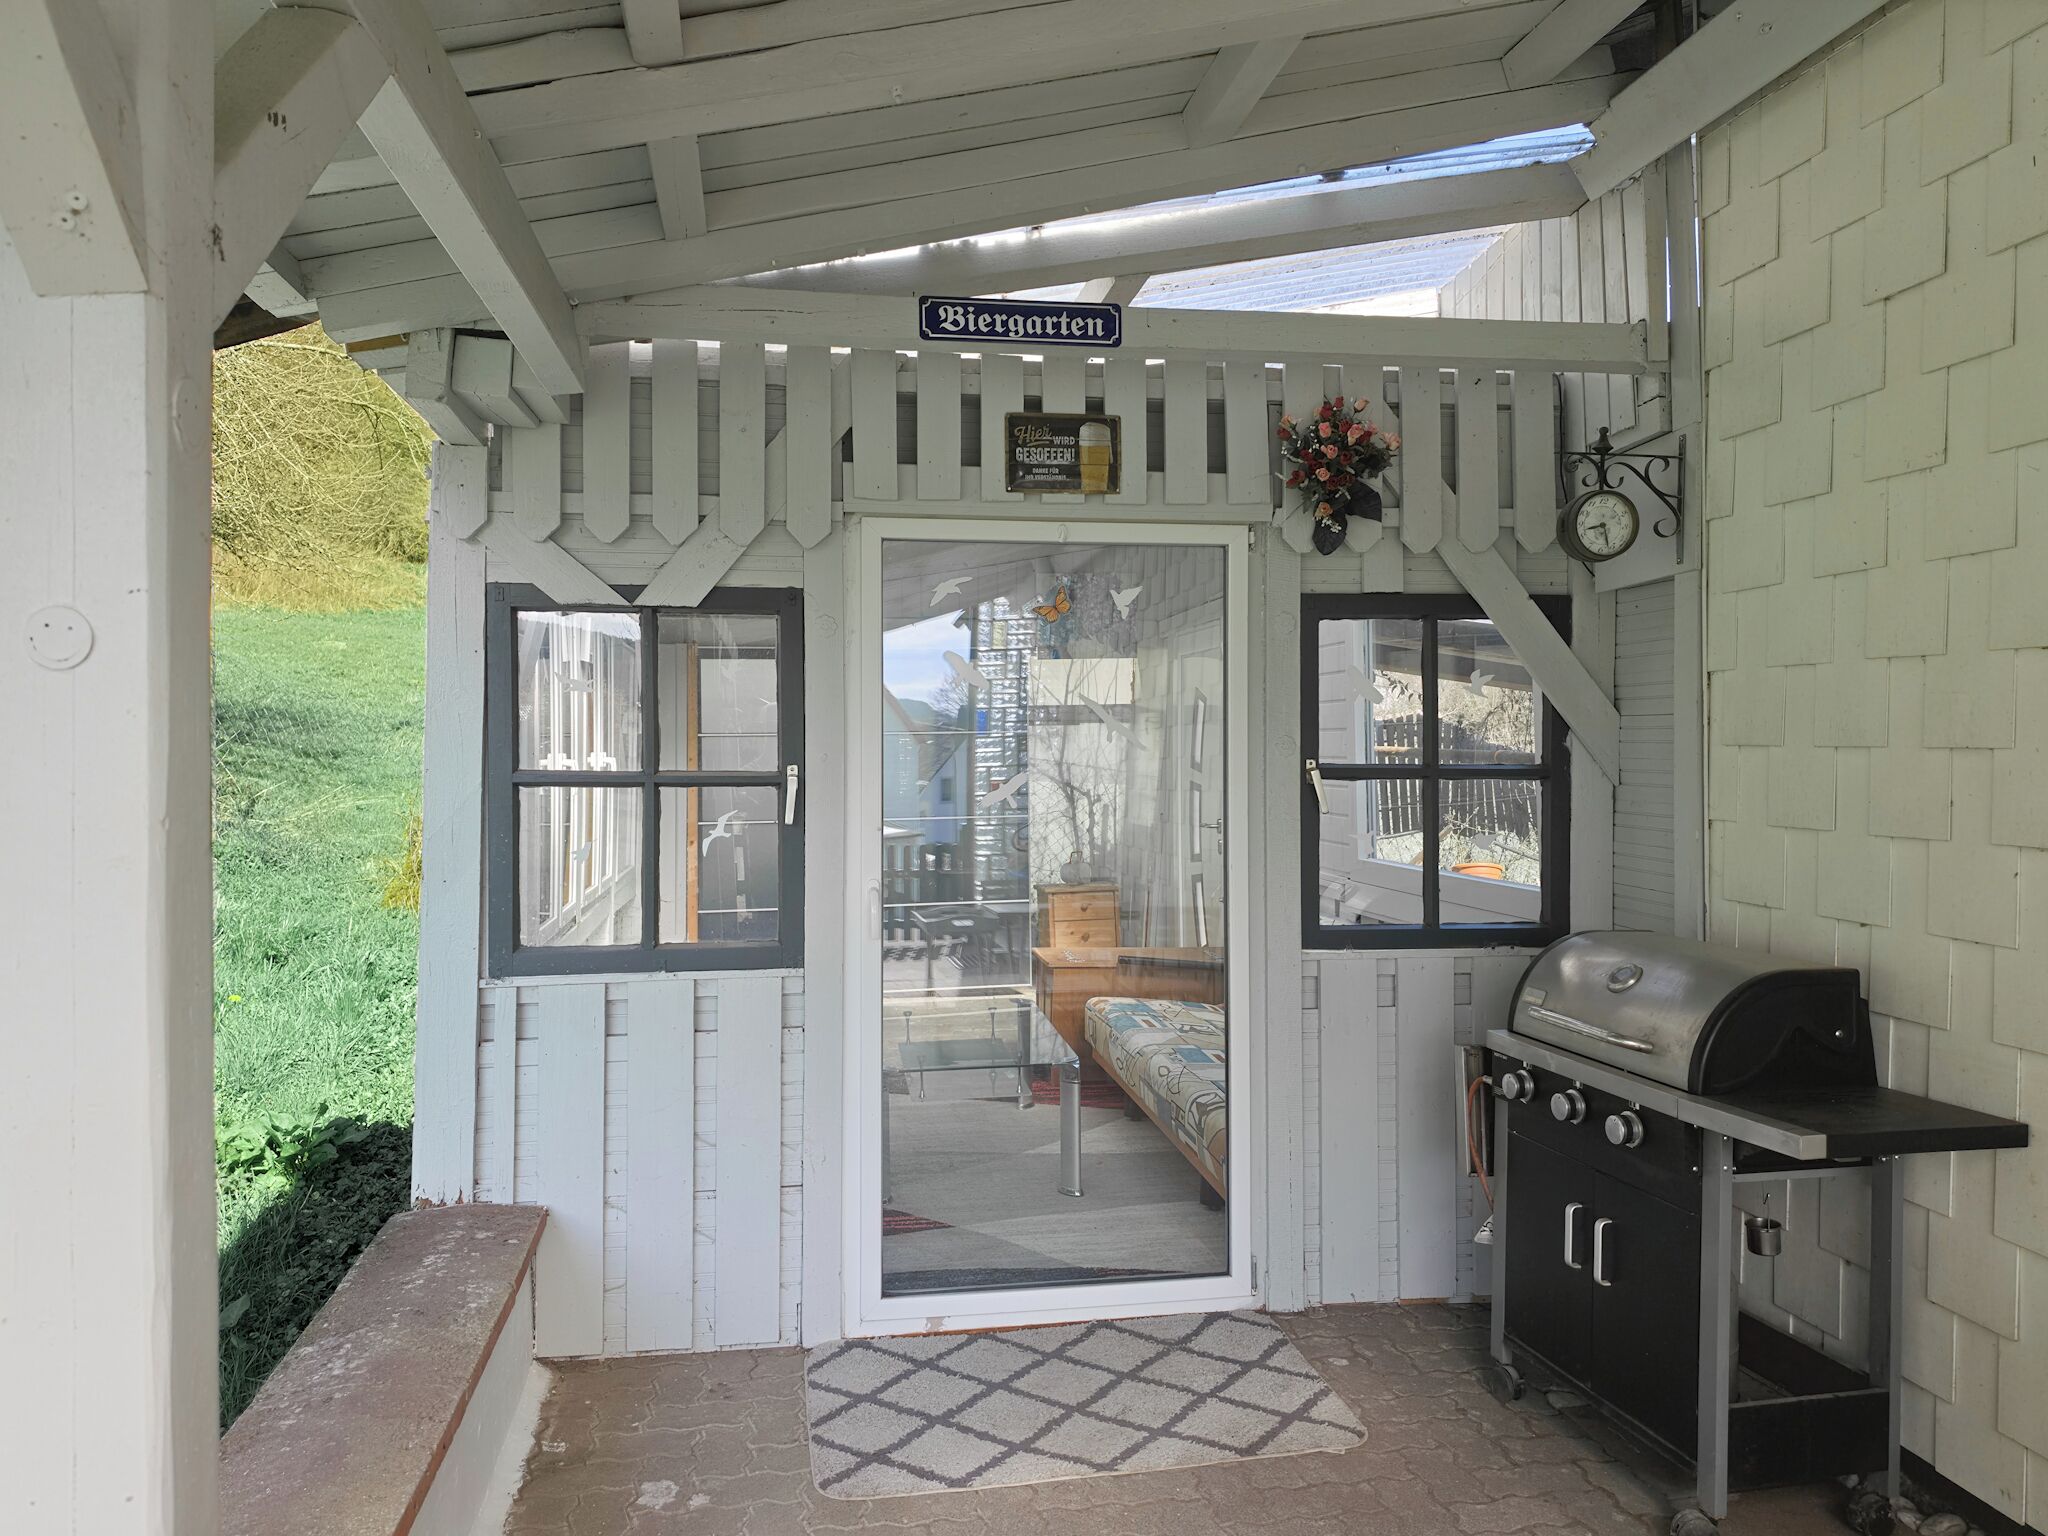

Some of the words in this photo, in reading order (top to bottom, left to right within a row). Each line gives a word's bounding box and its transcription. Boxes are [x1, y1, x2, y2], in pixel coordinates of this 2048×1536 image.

[938, 305, 1104, 337] Biergarten
[1014, 424, 1052, 445] Hier
[1053, 436, 1075, 445] WIRD
[1015, 447, 1075, 462] GESOFFEN!
